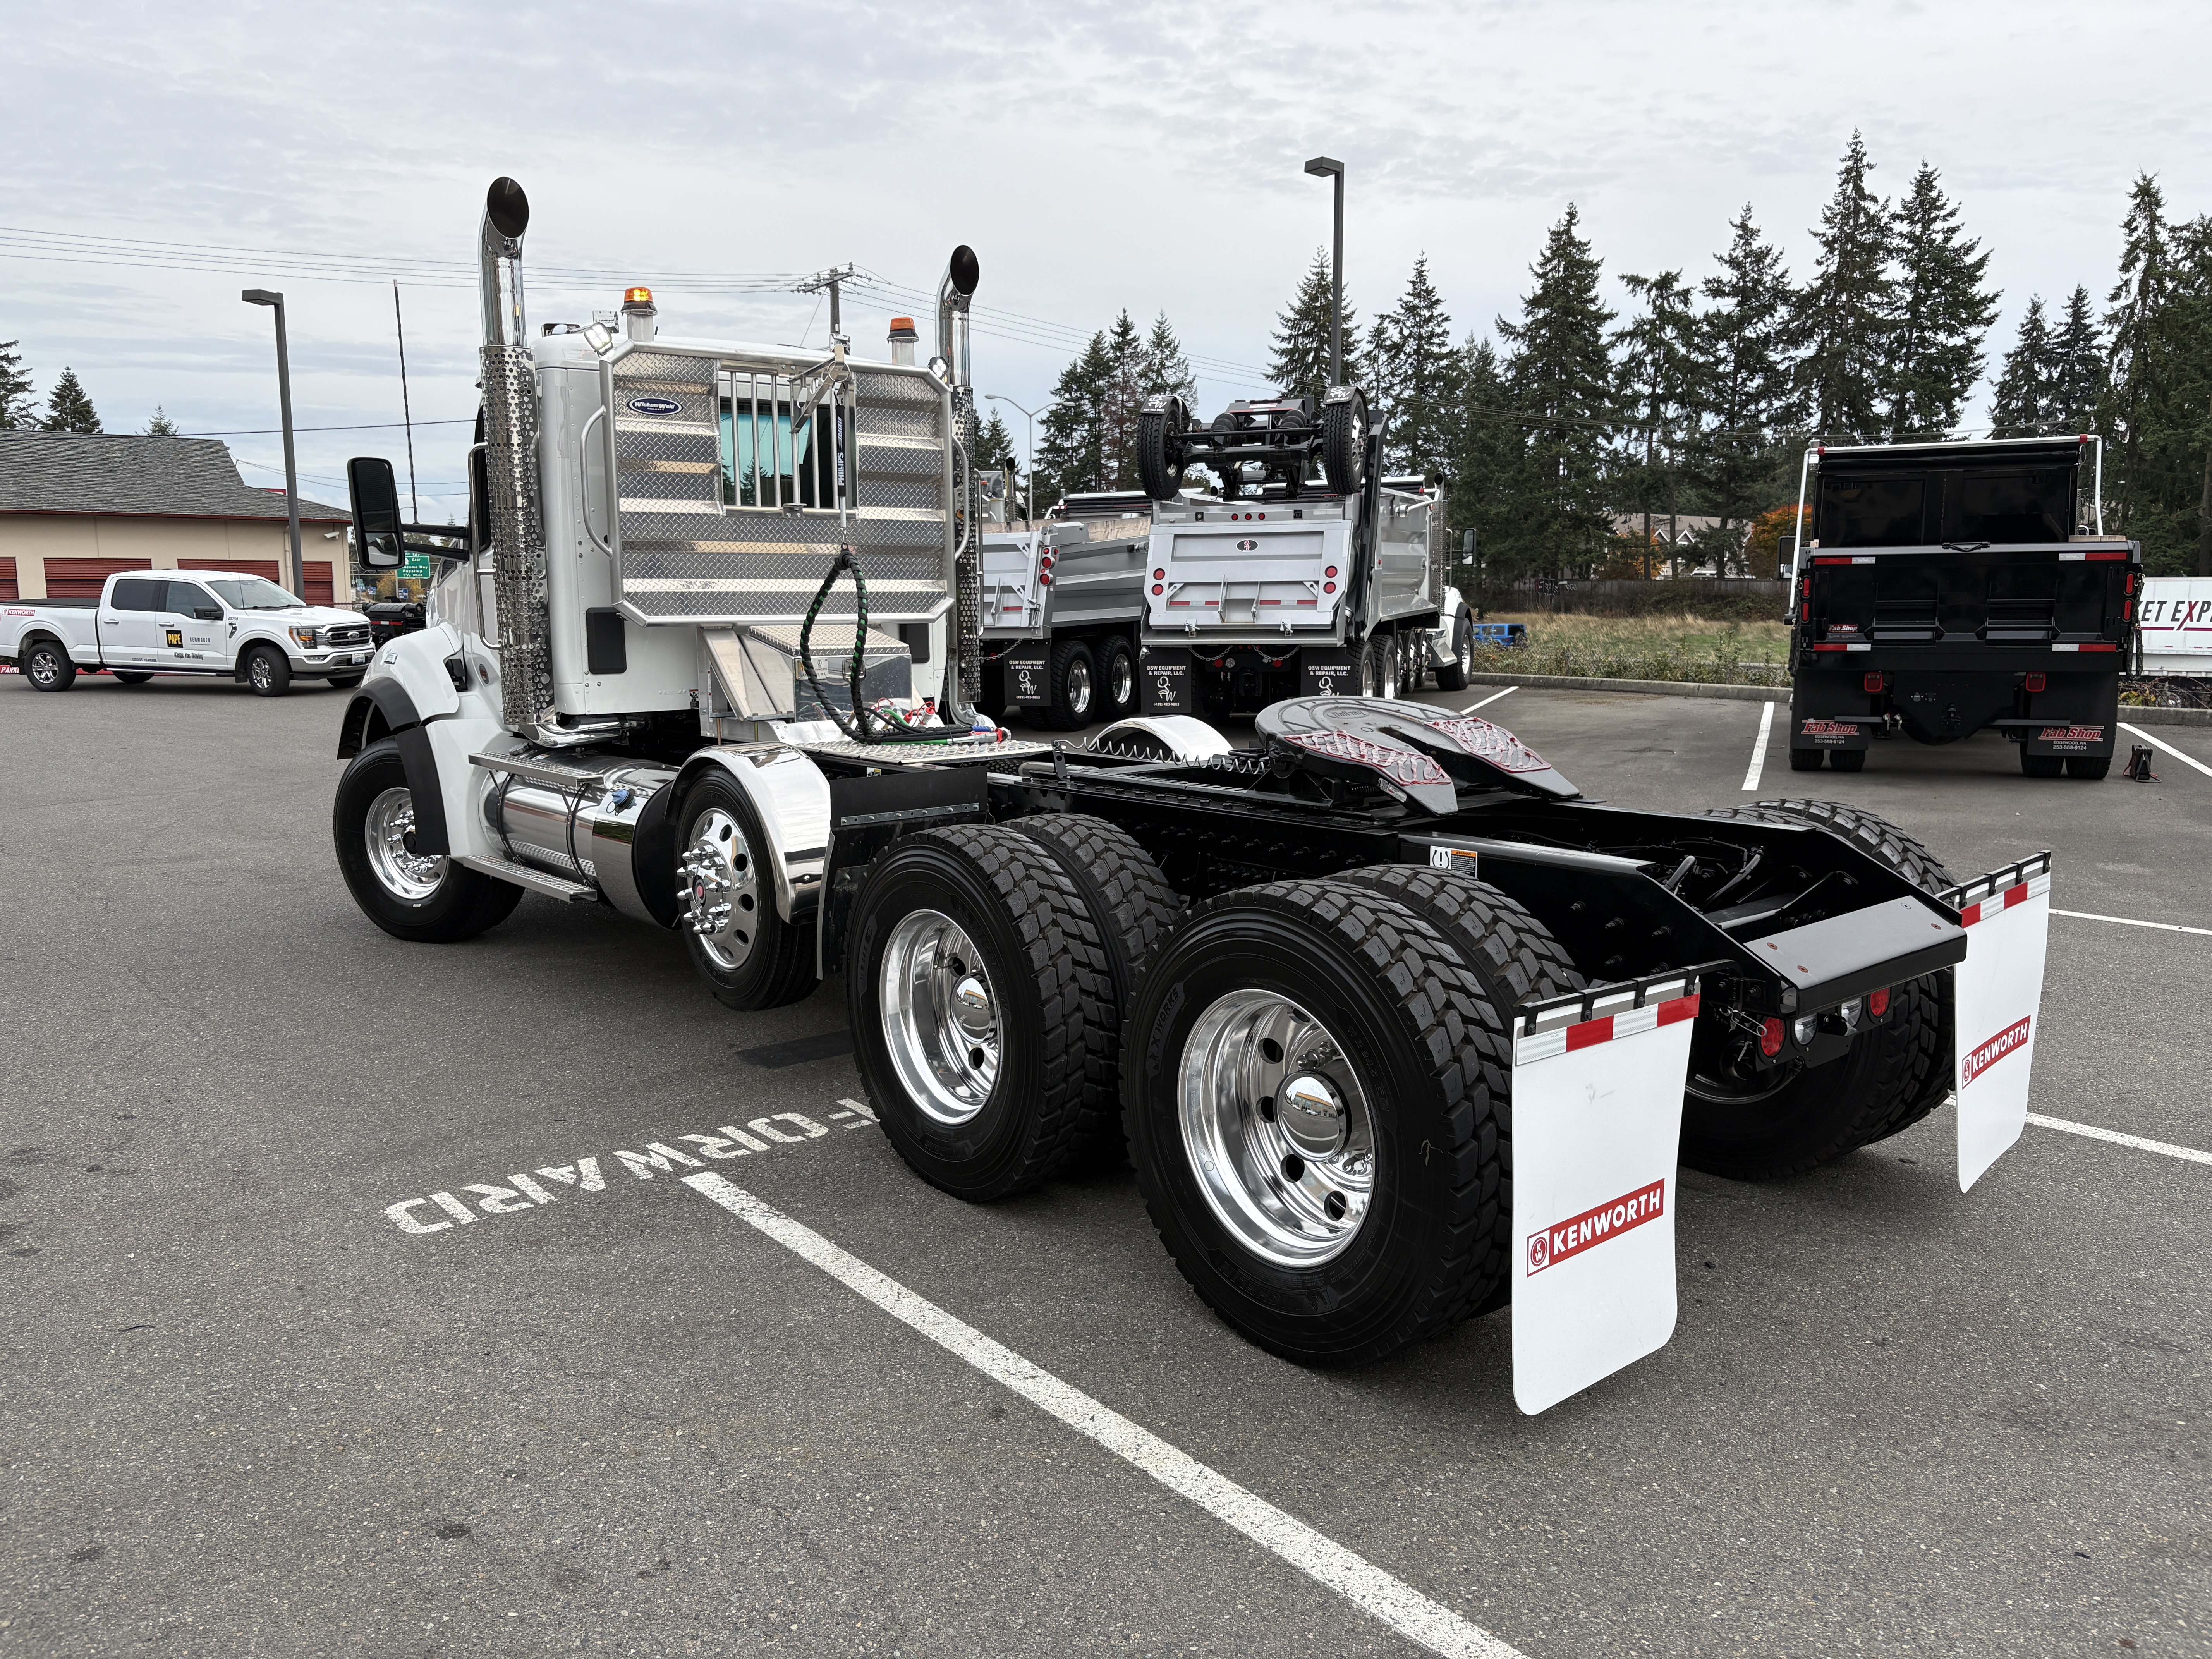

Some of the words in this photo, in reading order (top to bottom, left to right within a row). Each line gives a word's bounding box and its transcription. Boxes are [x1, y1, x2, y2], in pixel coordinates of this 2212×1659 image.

[2170, 600, 2212, 631] EXP
[1803, 722, 1826, 732] Fab
[1826, 722, 1858, 734] Shop
[2040, 726, 2066, 737] Fab
[2066, 727, 2102, 740] Shop
[1155, 986, 1180, 1034] WORKS
[1972, 1022, 2028, 1073] KENWORTH
[384, 1097, 881, 1234] FORWARD
[1553, 1188, 1661, 1256] KENWORTH
